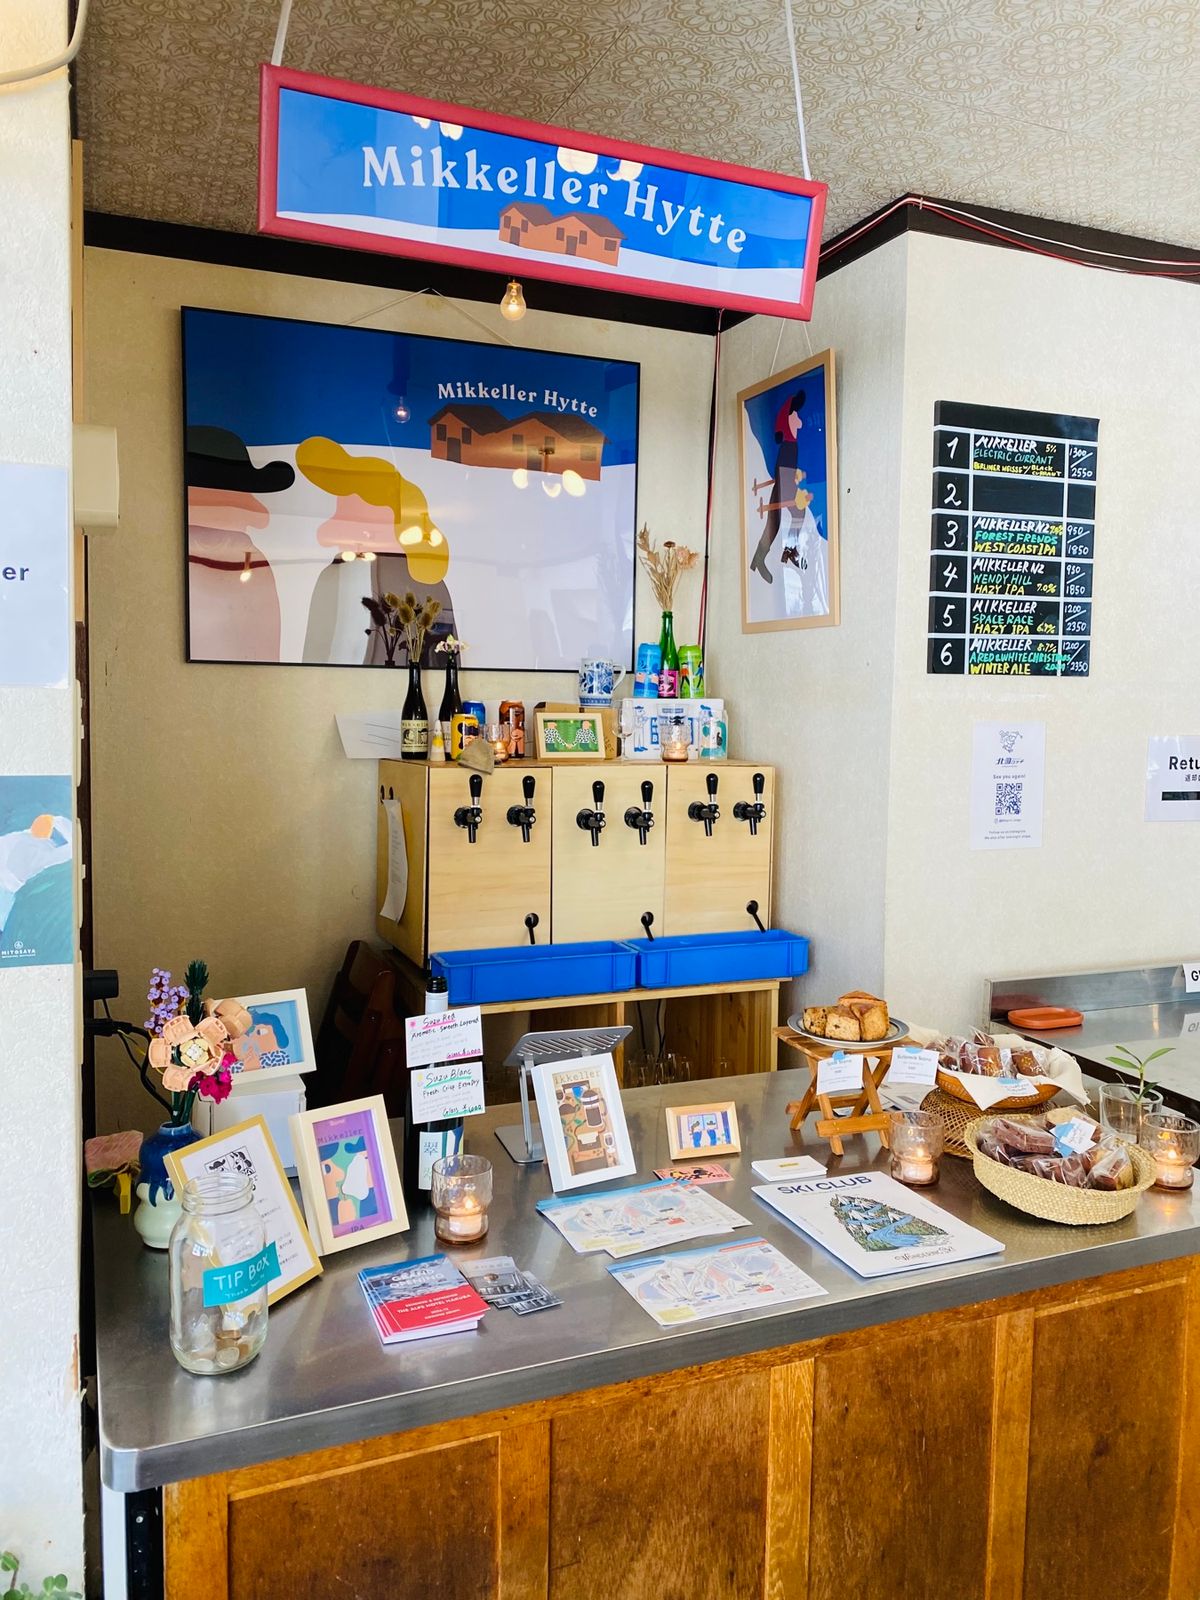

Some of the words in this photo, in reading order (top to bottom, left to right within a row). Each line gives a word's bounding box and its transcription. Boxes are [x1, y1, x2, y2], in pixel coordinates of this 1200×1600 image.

[362, 144, 608, 209] Mikkeller
[624, 180, 747, 254] Hytte
[437, 382, 537, 402] Mikkeller
[544, 389, 598, 417] Hytte
[946, 437, 959, 459] 1
[975, 436, 1038, 454] MIKKELLER
[1045, 443, 1057, 453] 5%
[974, 449, 1012, 462] ELECTRIC
[1014, 453, 1054, 465] CURRANT
[1071, 468, 1093, 478] 2550
[944, 483, 962, 507] 2
[974, 517, 1035, 532] MIKKELLER
[1067, 526, 1083, 535] 950
[944, 520, 958, 548] 3
[974, 530, 1015, 542] FOREST
[974, 541, 1006, 553] WEST
[1007, 543, 1039, 555] COAST
[1039, 544, 1056, 556] IPA
[1068, 544, 1089, 555] 1850
[972, 559, 1029, 573] MIKKELLER
[1066, 565, 1081, 575] 950
[2, 566, 29, 581] er
[943, 562, 958, 588] 4
[973, 573, 1009, 585] WENDY
[1010, 574, 1033, 585] HILL
[974, 585, 1002, 595] HAZY
[1004, 584, 1025, 595] IPA
[1066, 585, 1086, 595] 1850
[972, 600, 1037, 614] MIKKELLER
[1064, 605, 1081, 613] 1200
[942, 604, 956, 627] 5
[972, 614, 1004, 625] SPACE
[1007, 615, 1034, 626] RACE
[973, 624, 1007, 635] HAZY
[1011, 624, 1030, 635] IPA
[1066, 622, 1087, 632] 2350
[970, 639, 1032, 653] MIKKELLER
[1063, 641, 1079, 650] 1200
[940, 642, 953, 666] 6
[977, 652, 995, 662] RED
[1000, 653, 1028, 663] WHITE
[970, 663, 1010, 675] WINTER
[1010, 664, 1031, 675] ALE
[1070, 661, 1088, 672] 2350
[442, 1013, 456, 1024] Red
[425, 1071, 451, 1087] Suzu
[451, 1067, 472, 1081] Blanc
[317, 1127, 363, 1146] Mikkeller
[777, 1184, 812, 1195] SKI
[815, 1175, 873, 1191] CLUB
[350, 1222, 365, 1234] IPA
[212, 1270, 244, 1290] TIP
[248, 1256, 271, 1283] BOX
[389, 1272, 445, 1288] OPENING
[391, 1268, 434, 1282] GRAND
[426, 1299, 445, 1309] HOTEL
